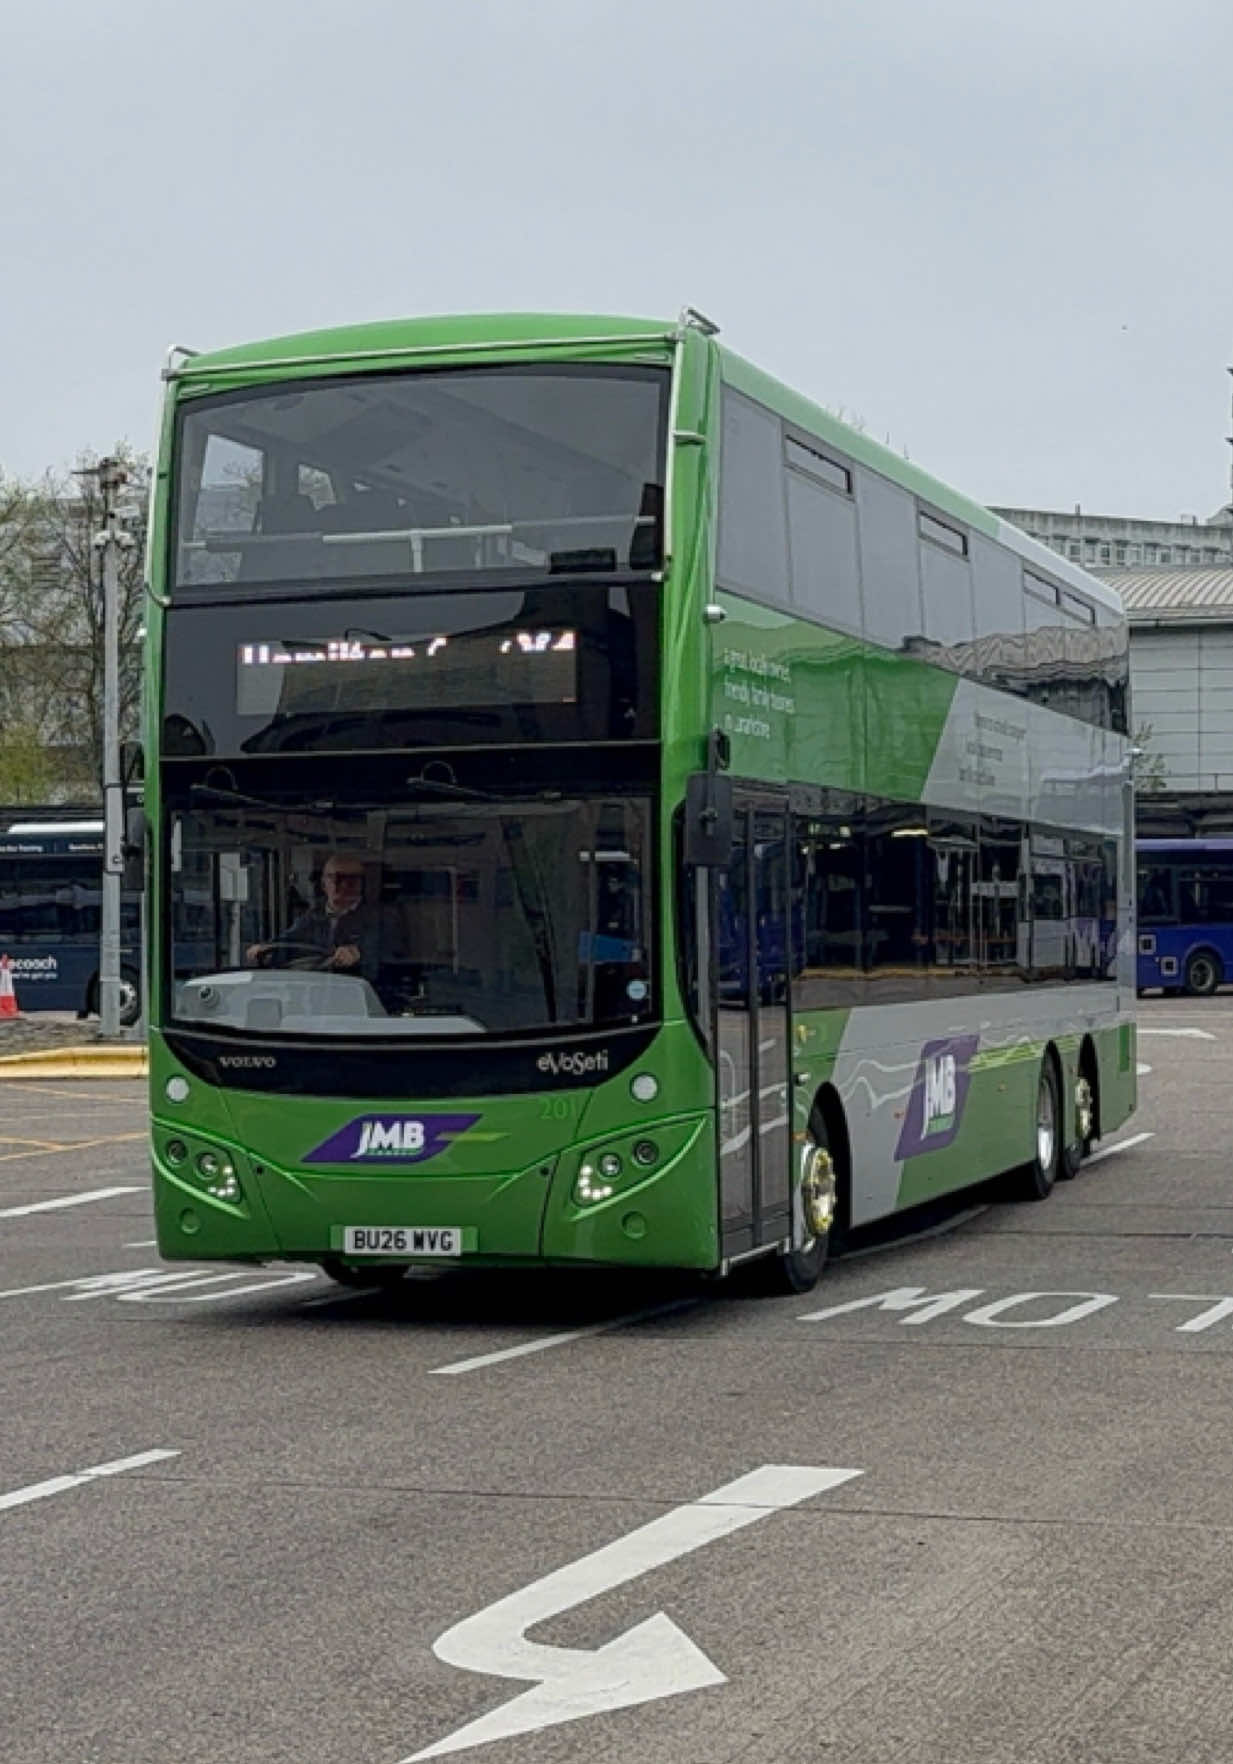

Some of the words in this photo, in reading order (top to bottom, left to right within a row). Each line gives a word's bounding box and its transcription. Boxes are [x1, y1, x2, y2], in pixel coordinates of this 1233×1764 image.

[219, 1056, 276, 1068] VOLVO
[920, 1054, 957, 1140] JMB
[350, 1120, 425, 1159] JMB
[353, 1229, 407, 1250] BU26
[412, 1229, 454, 1250] WVG
